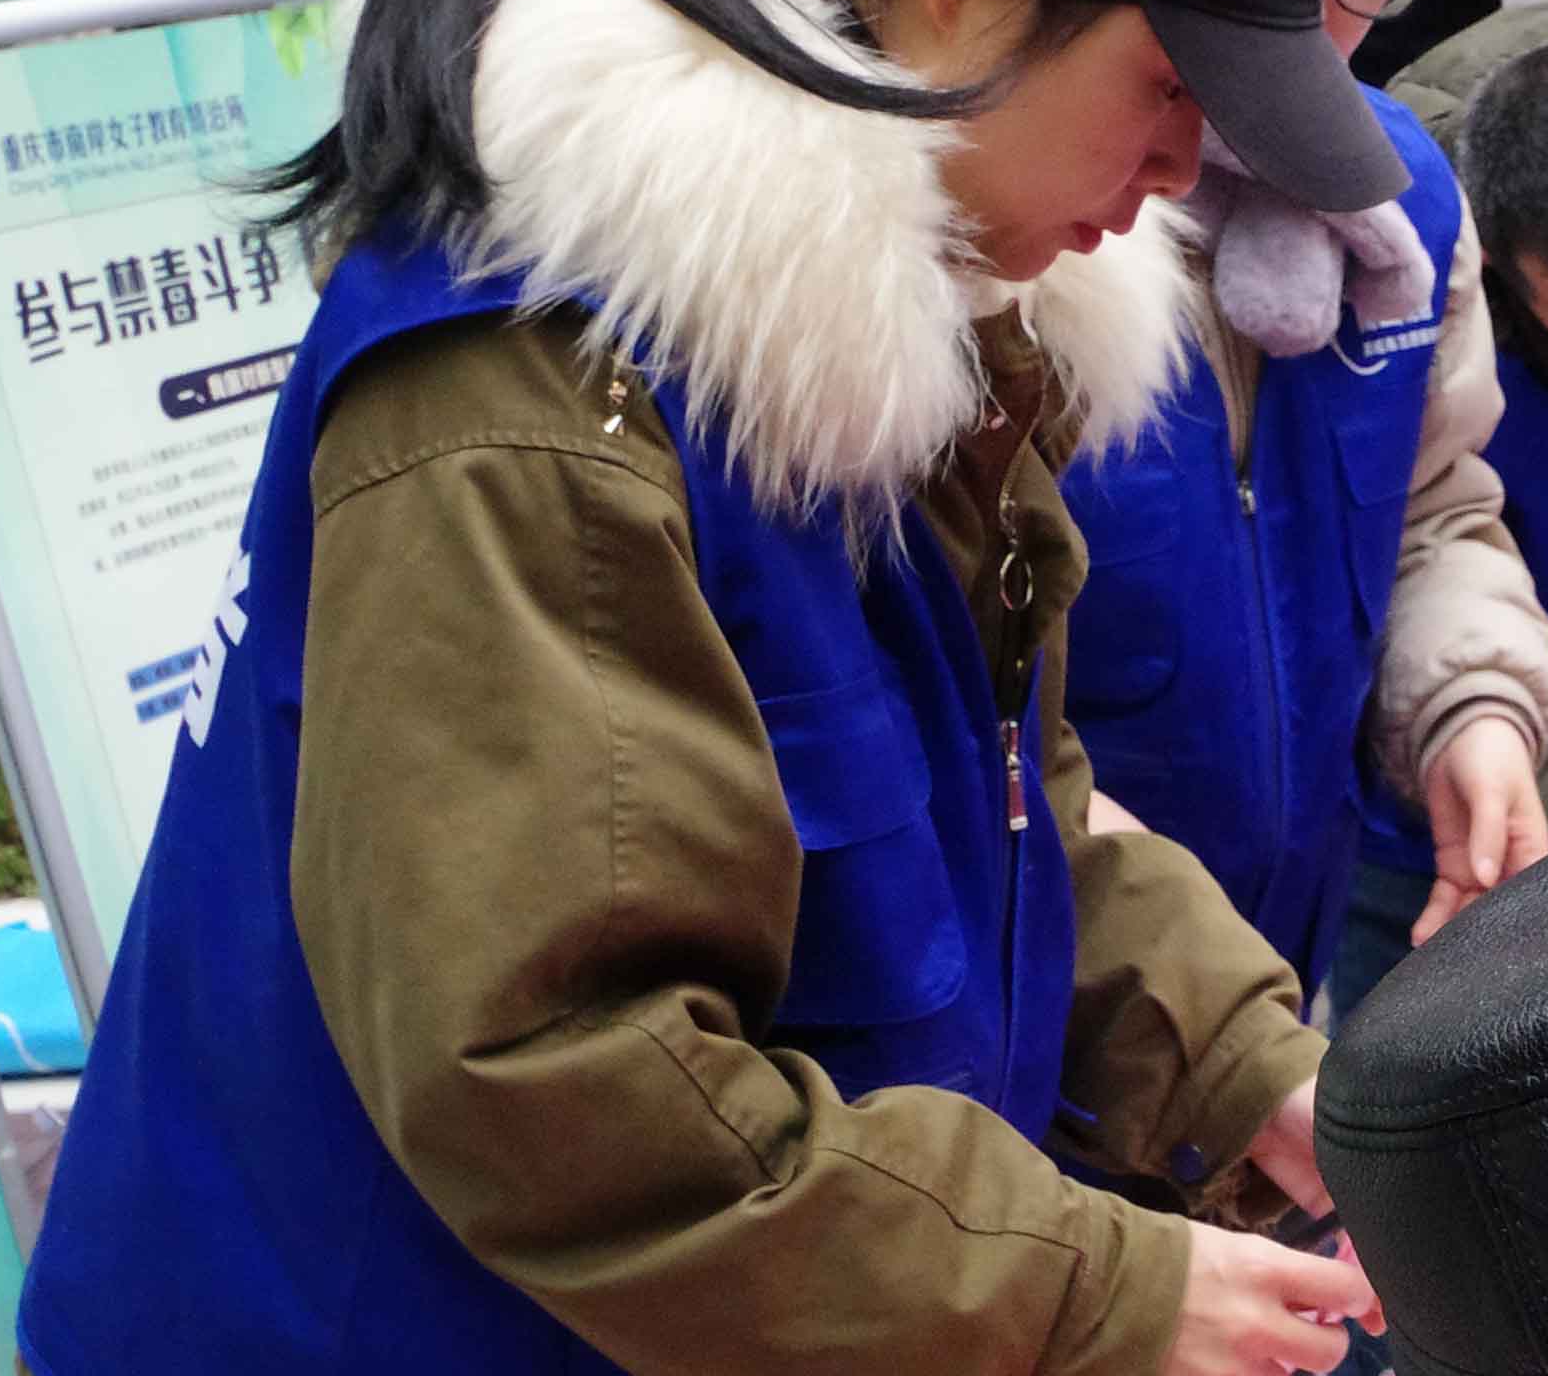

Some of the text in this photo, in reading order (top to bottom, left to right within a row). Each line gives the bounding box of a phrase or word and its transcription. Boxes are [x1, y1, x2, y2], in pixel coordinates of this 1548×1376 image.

[15, 226, 281, 363] 参与禁毒斗争
